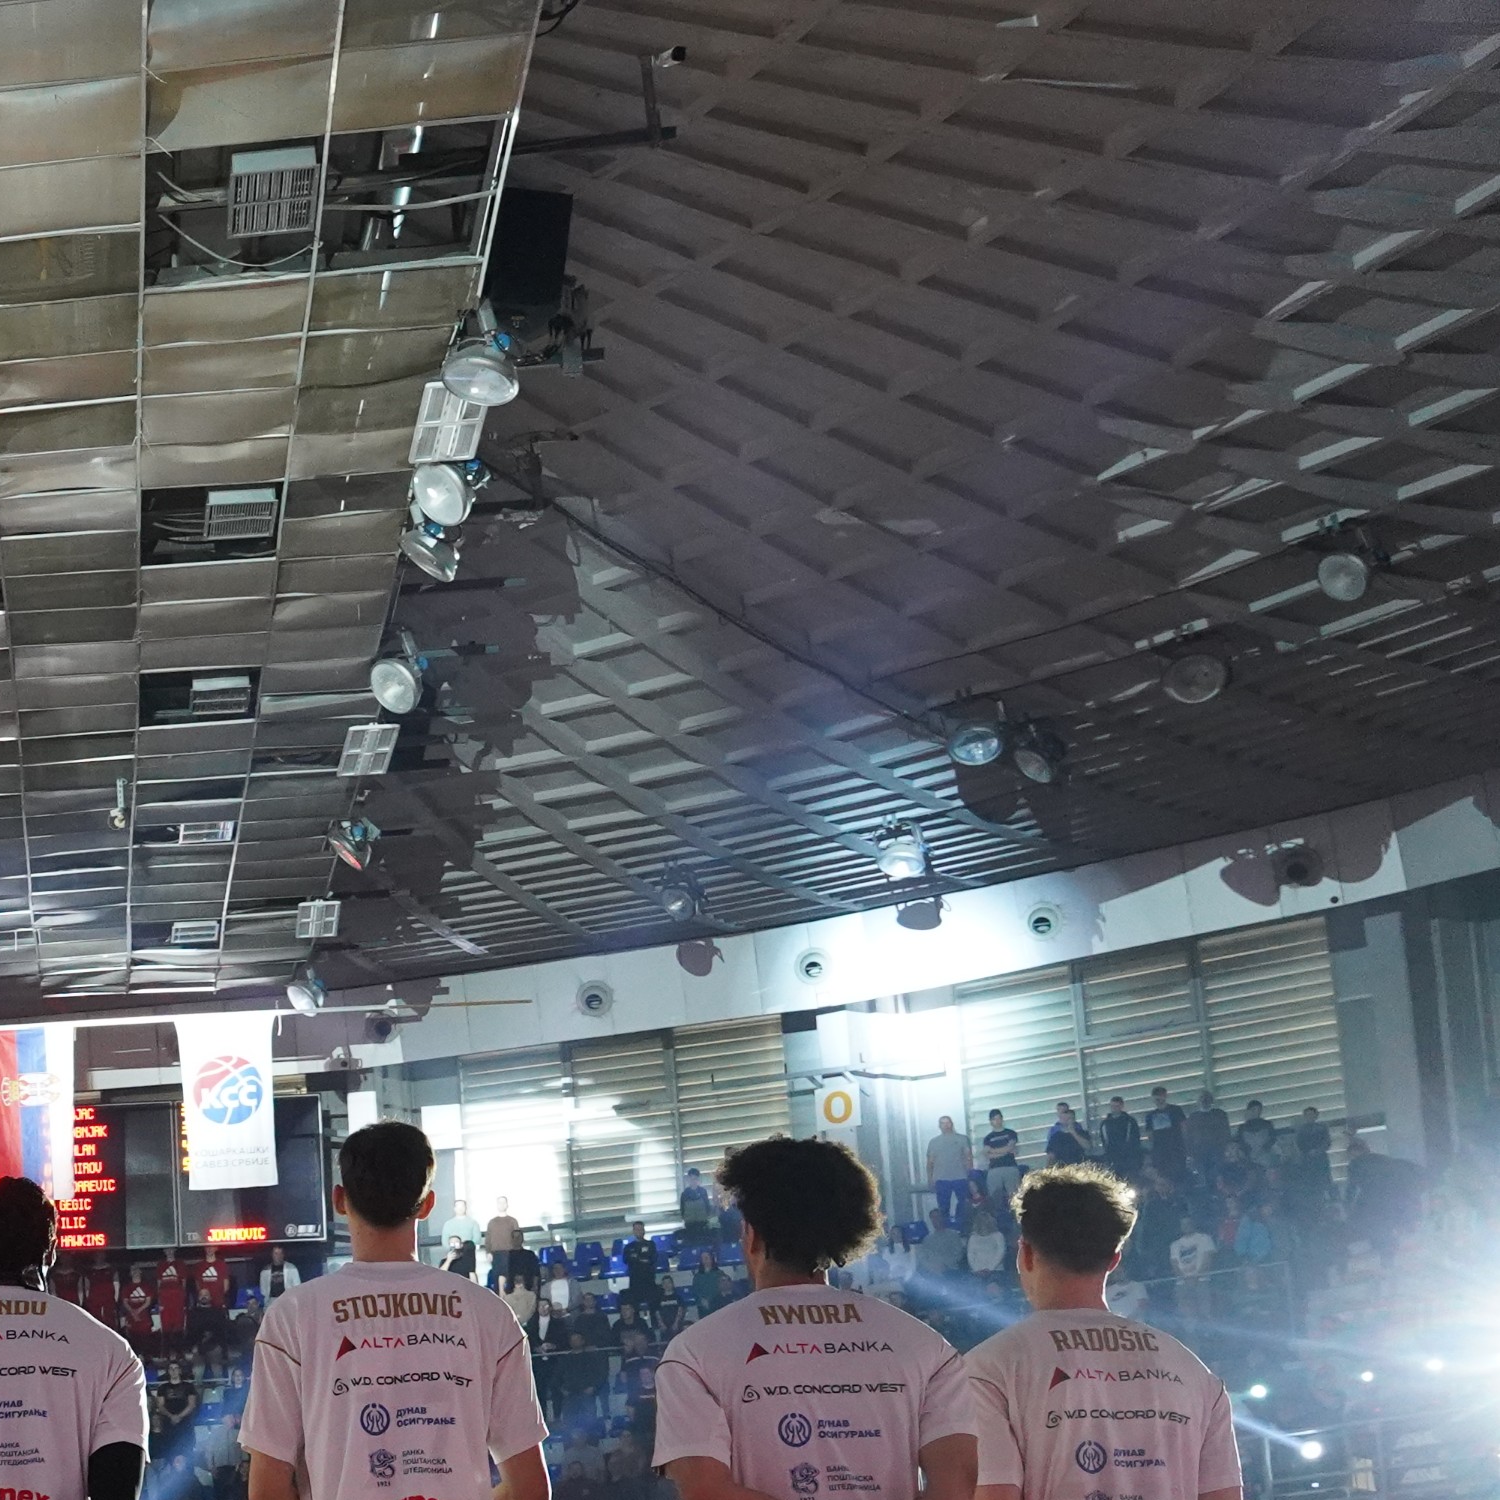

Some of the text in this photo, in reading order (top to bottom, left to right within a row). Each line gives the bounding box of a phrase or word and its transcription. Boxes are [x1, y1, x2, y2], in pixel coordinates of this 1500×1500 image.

[61, 1217, 86, 1229] ILIC
[61, 1234, 105, 1247] HAWKINS
[208, 1227, 266, 1241] JOVANOVIC
[333, 1291, 462, 1323] STOJKOVIĆ
[758, 1304, 863, 1325] NWORA
[1049, 1325, 1158, 1352] RADOŠIĆ
[38, 1366, 77, 1378] WEST
[351, 1377, 374, 1386] W.D.
[377, 1372, 440, 1385] CONCORD
[764, 1383, 906, 1395] W.D. CONCORD WEST
[1090, 1409, 1156, 1420] CONCORD
